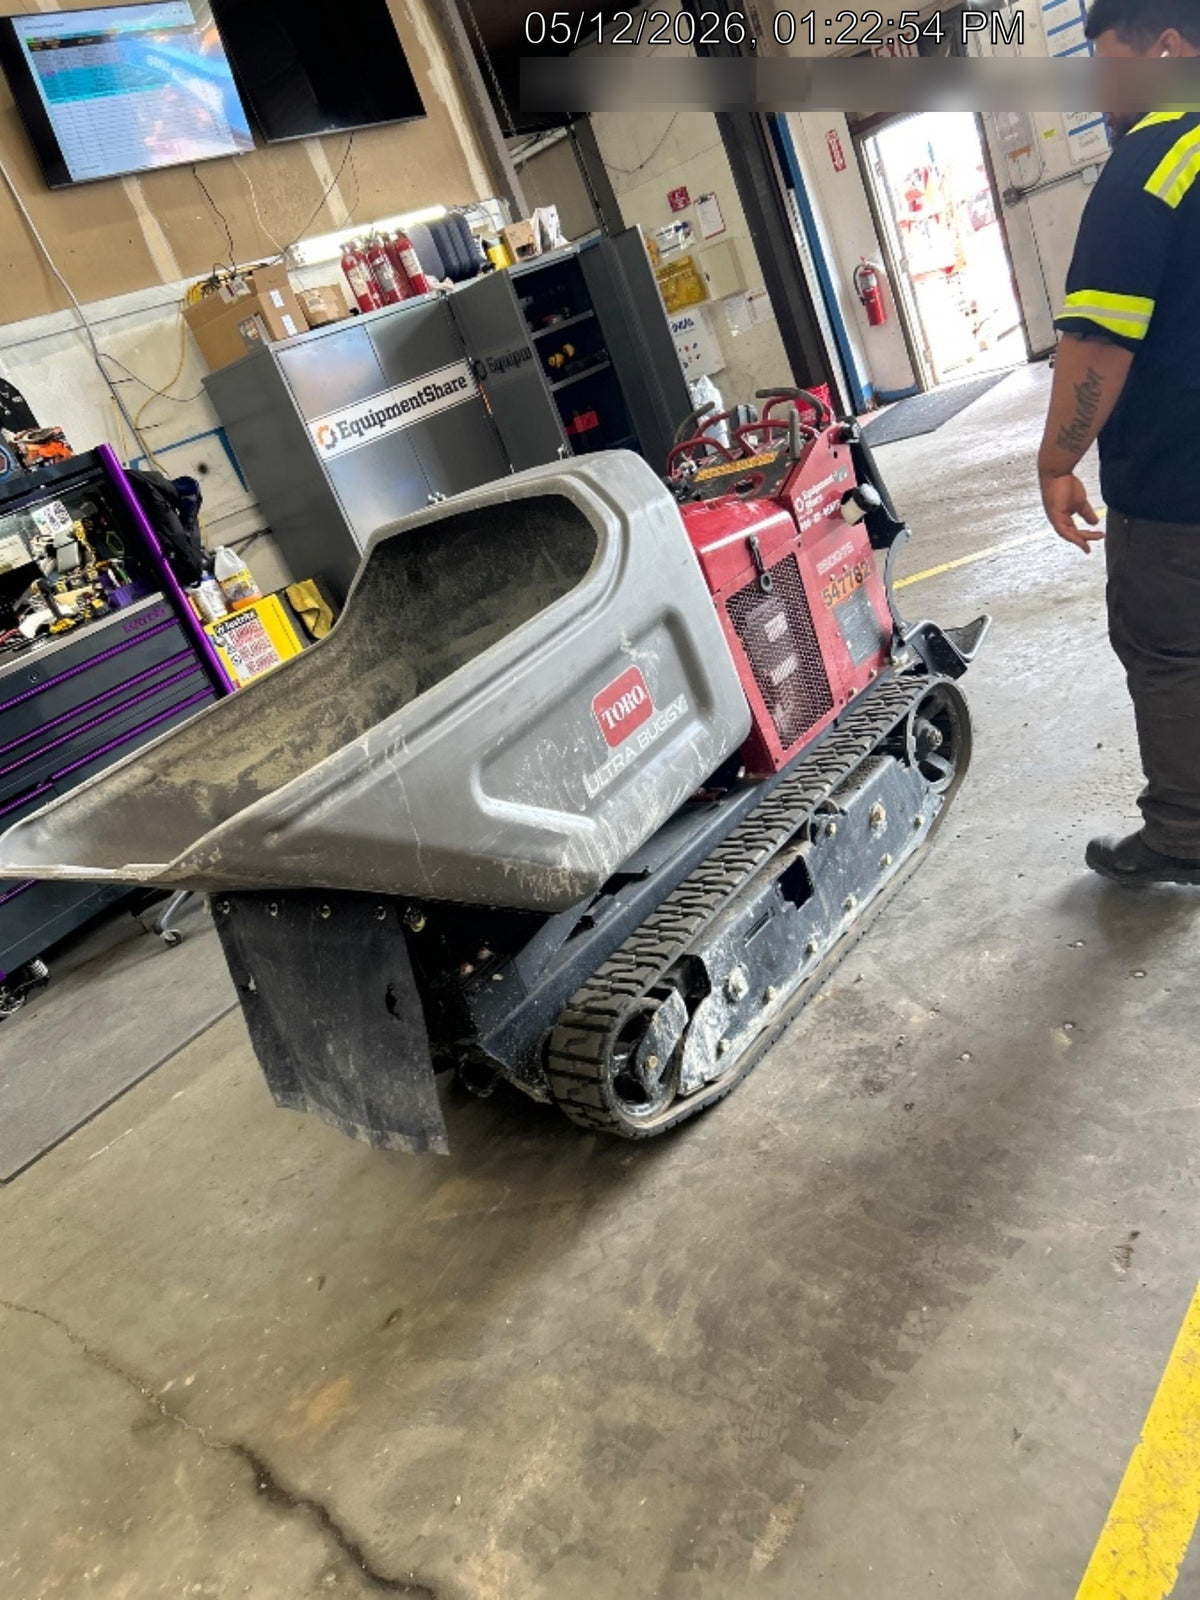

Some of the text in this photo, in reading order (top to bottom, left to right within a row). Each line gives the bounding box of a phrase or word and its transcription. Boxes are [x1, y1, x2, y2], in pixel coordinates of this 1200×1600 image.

[336, 375, 468, 441] EquipmentShare
[822, 560, 871, 608] 547782
[601, 685, 648, 730] TORO
[582, 693, 687, 799] ULTRA BUGGY
